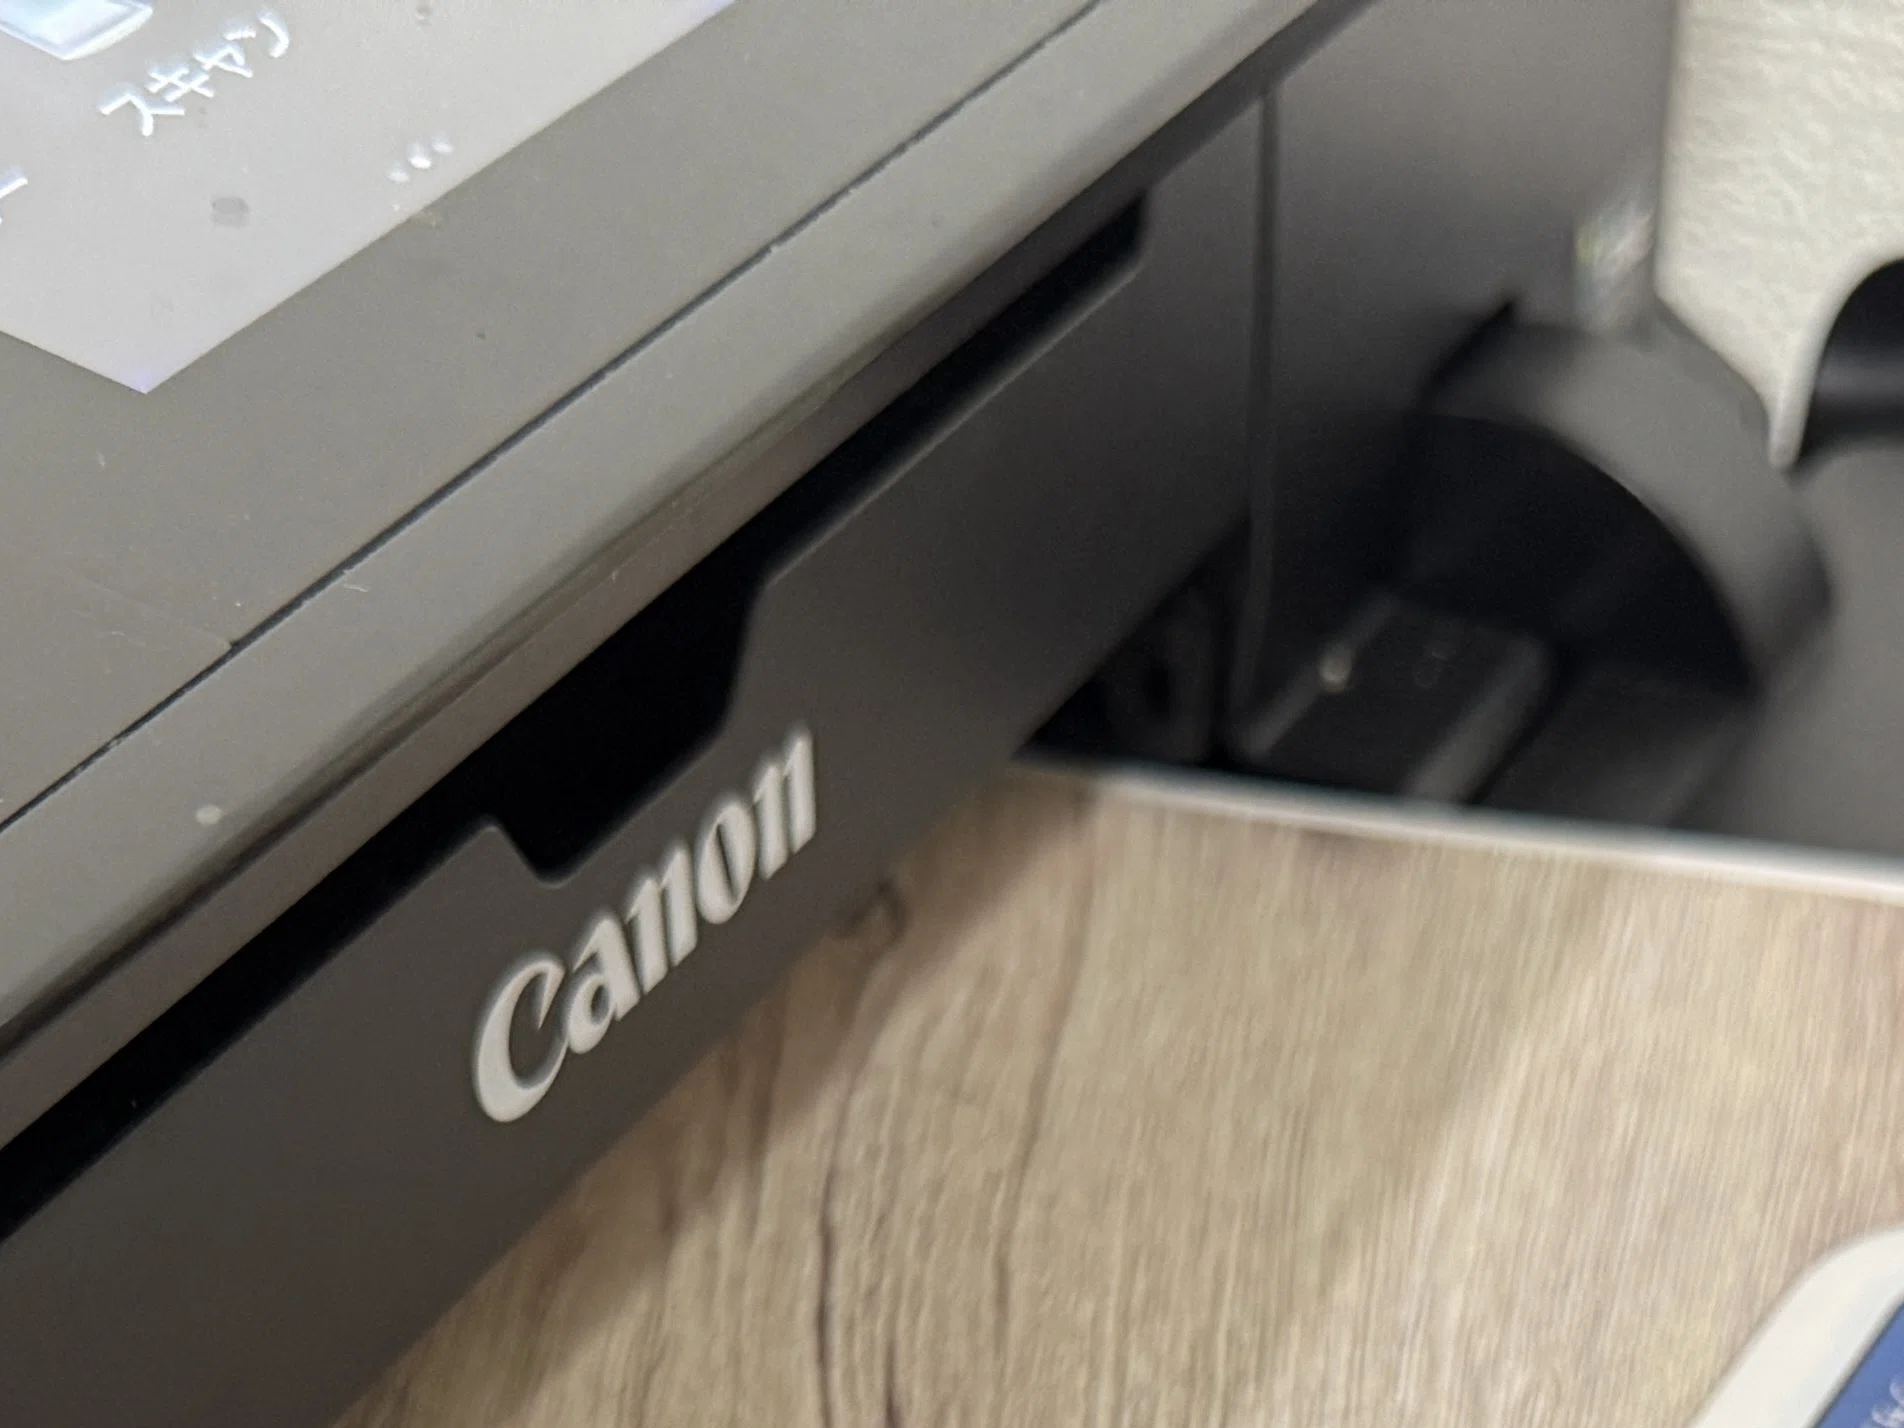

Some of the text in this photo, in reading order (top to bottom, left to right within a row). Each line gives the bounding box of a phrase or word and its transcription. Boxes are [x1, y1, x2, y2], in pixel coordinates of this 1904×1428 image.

[98, 8, 292, 137] スキャン
[470, 716, 816, 1122] Canon
